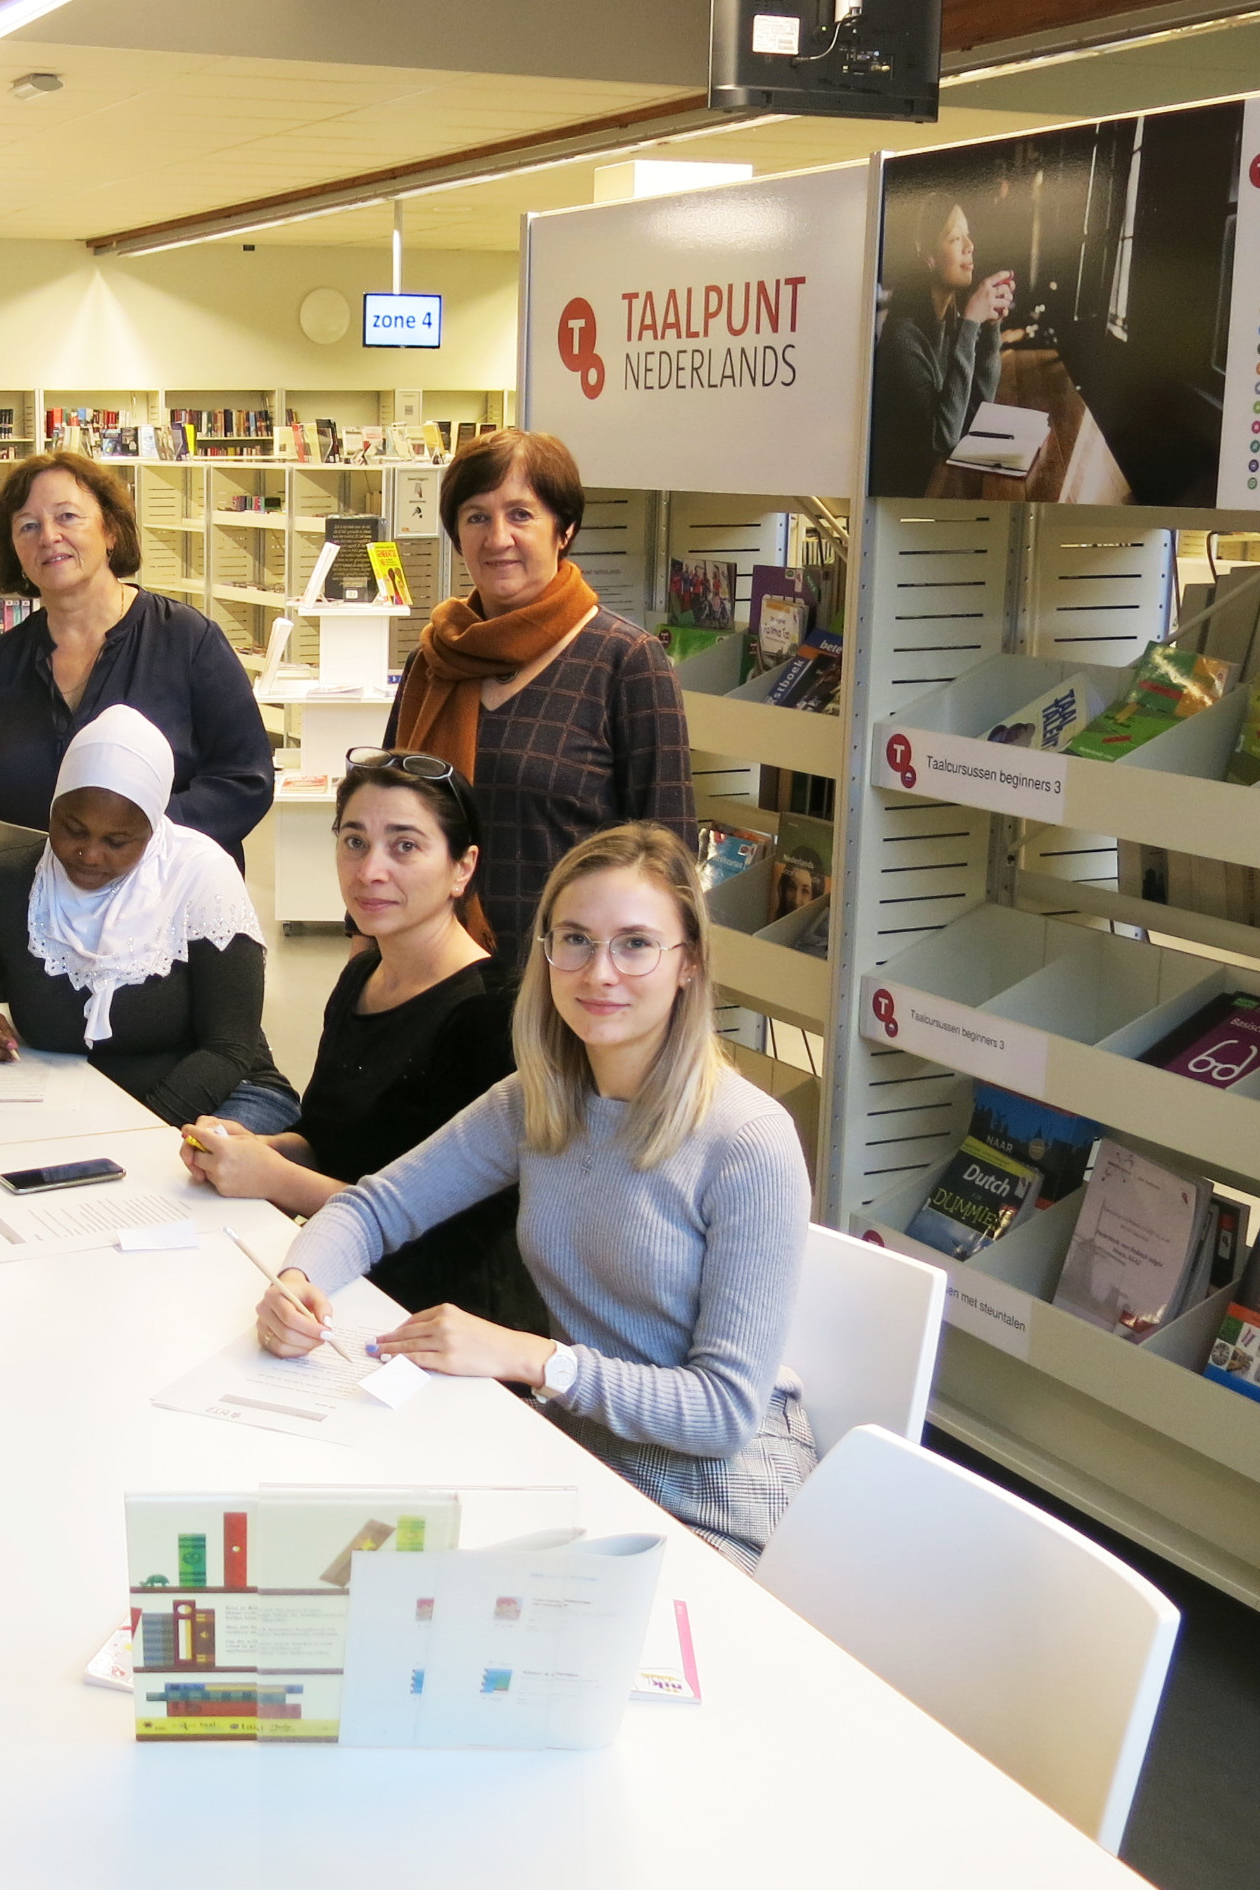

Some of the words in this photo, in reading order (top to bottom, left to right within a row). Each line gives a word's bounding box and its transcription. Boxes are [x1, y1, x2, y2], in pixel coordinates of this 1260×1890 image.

[373, 314, 415, 329] zone
[422, 311, 432, 329] 4
[621, 276, 806, 342] TAALPUNT
[624, 344, 796, 390] NEDERLANDS
[1053, 688, 1077, 727] TAAL
[926, 755, 997, 781] Taalcursussen
[999, 770, 1051, 792] beginners
[1054, 780, 1061, 794] 3
[910, 1009, 961, 1036] Taalcursussen
[962, 1028, 998, 1048] beginners
[999, 1040, 1005, 1050] 3
[986, 1135, 1014, 1153] NAAR
[962, 1163, 1011, 1198] Dutch
[946, 1287, 959, 1299] en
[961, 1292, 978, 1308] met
[979, 1303, 1026, 1332] steuntalen
